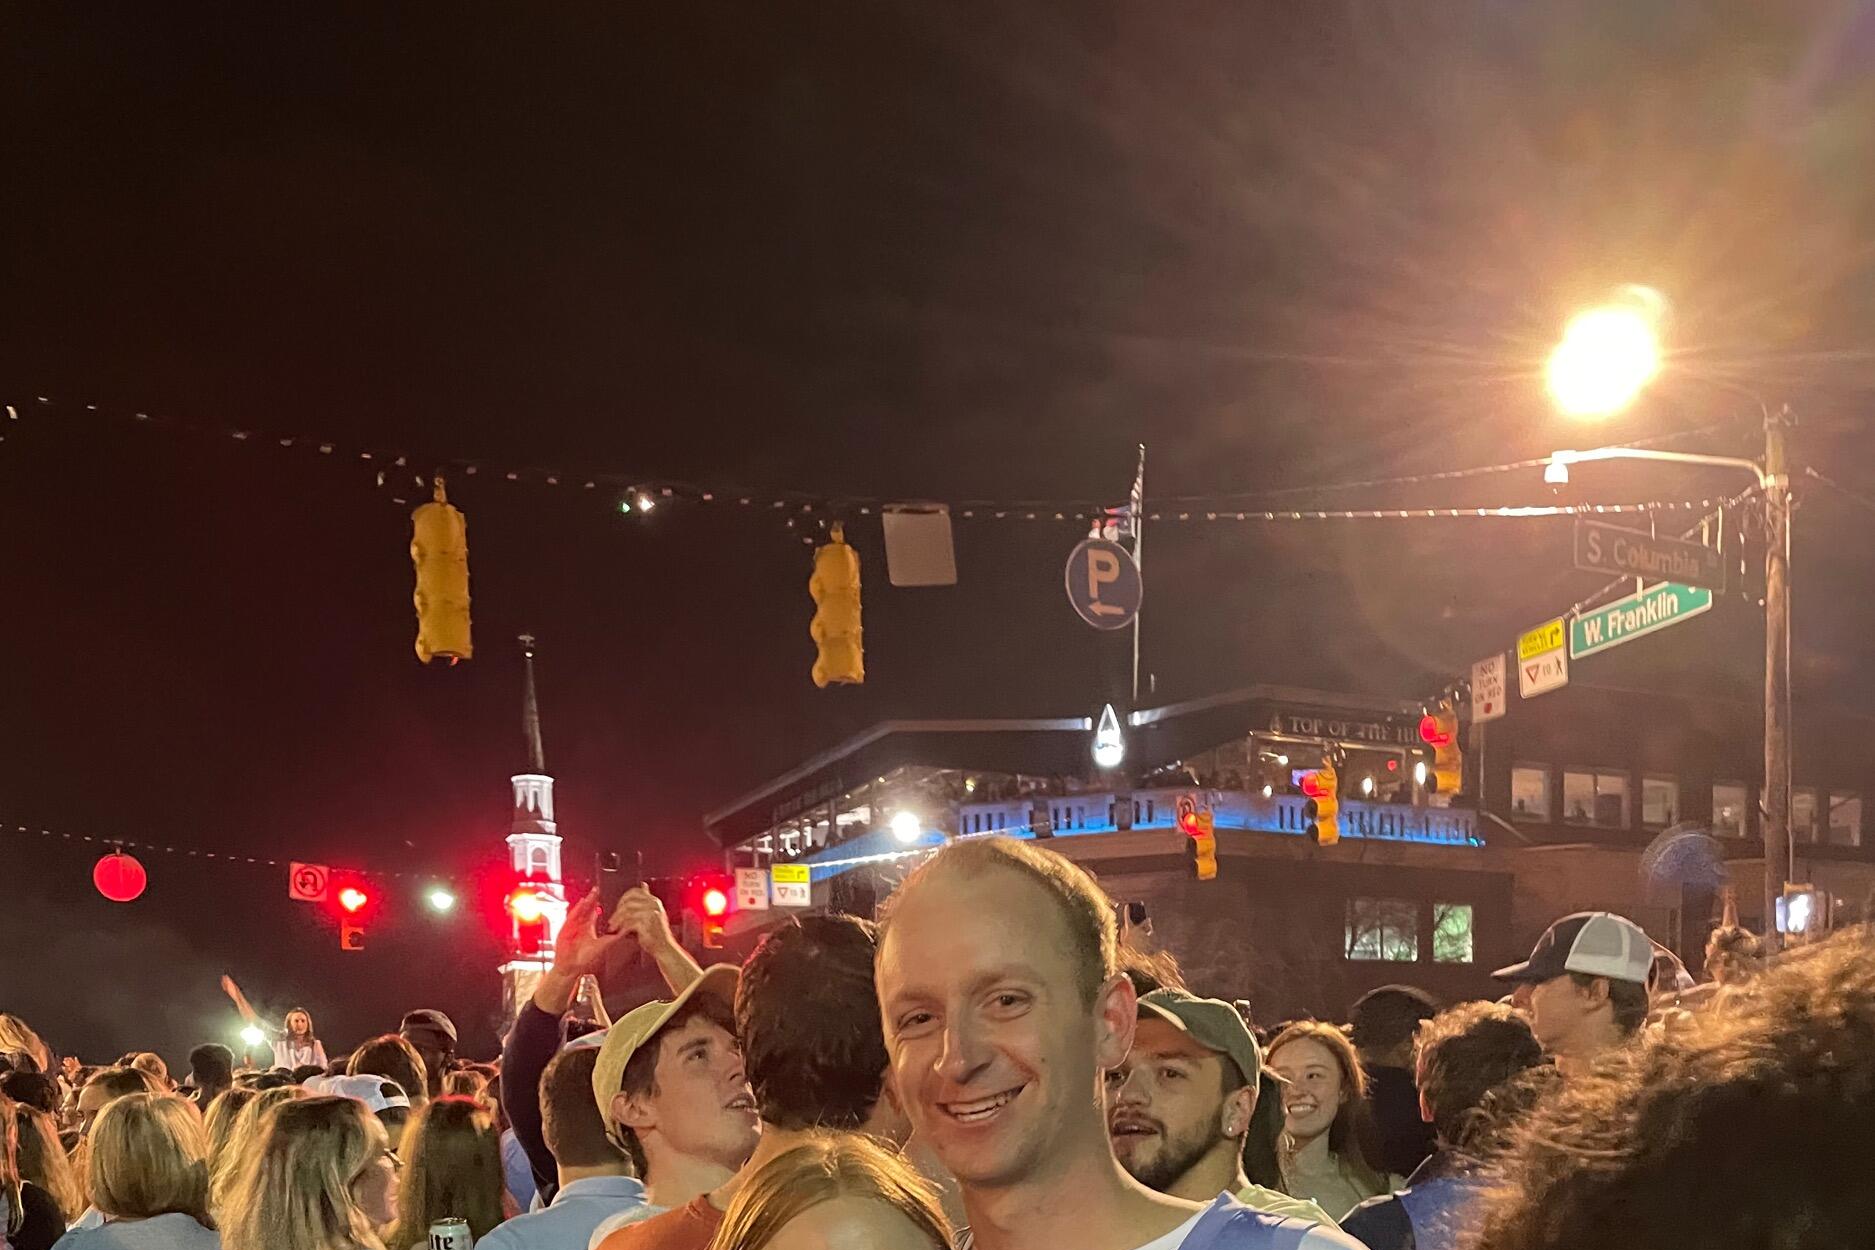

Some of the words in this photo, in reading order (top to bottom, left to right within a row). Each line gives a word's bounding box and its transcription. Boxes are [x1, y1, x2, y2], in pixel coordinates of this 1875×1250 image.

[1087, 548, 1120, 600] P
[1586, 529, 1607, 564] S.
[1613, 536, 1699, 578] Columbia
[1583, 616, 1604, 647] W.
[1607, 590, 1679, 639] Franklin
[1288, 715, 1322, 735] TOP
